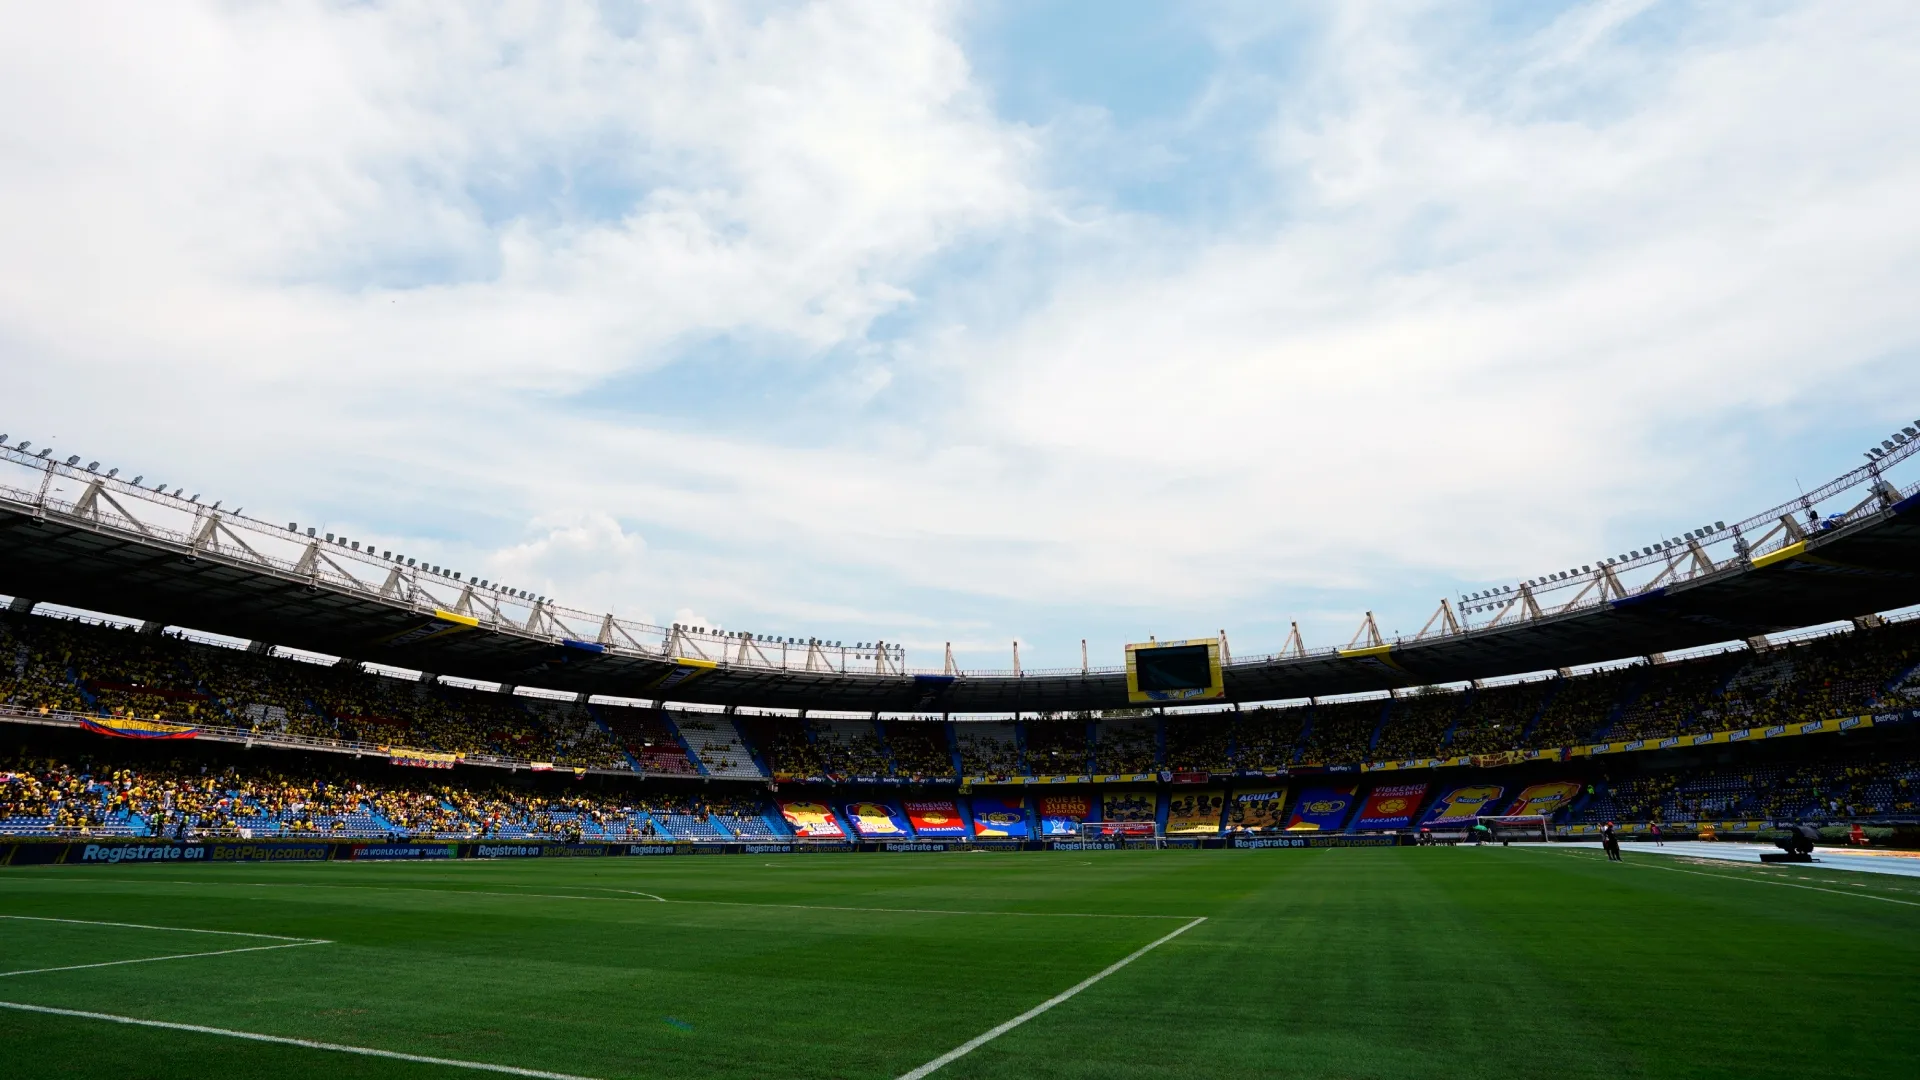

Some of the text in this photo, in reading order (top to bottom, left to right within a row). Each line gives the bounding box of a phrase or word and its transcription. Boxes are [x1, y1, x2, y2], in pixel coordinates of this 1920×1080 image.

[1238, 791, 1279, 802] AGUILA
[1104, 842, 1115, 850] en
[1291, 839, 1304, 847] en
[82, 844, 205, 863] Regístrate en
[212, 845, 326, 861] BetPlay.com.co
[370, 848, 393, 856] WORLD
[394, 848, 408, 856] CUP
[527, 846, 539, 857] en
[663, 846, 674, 854] en
